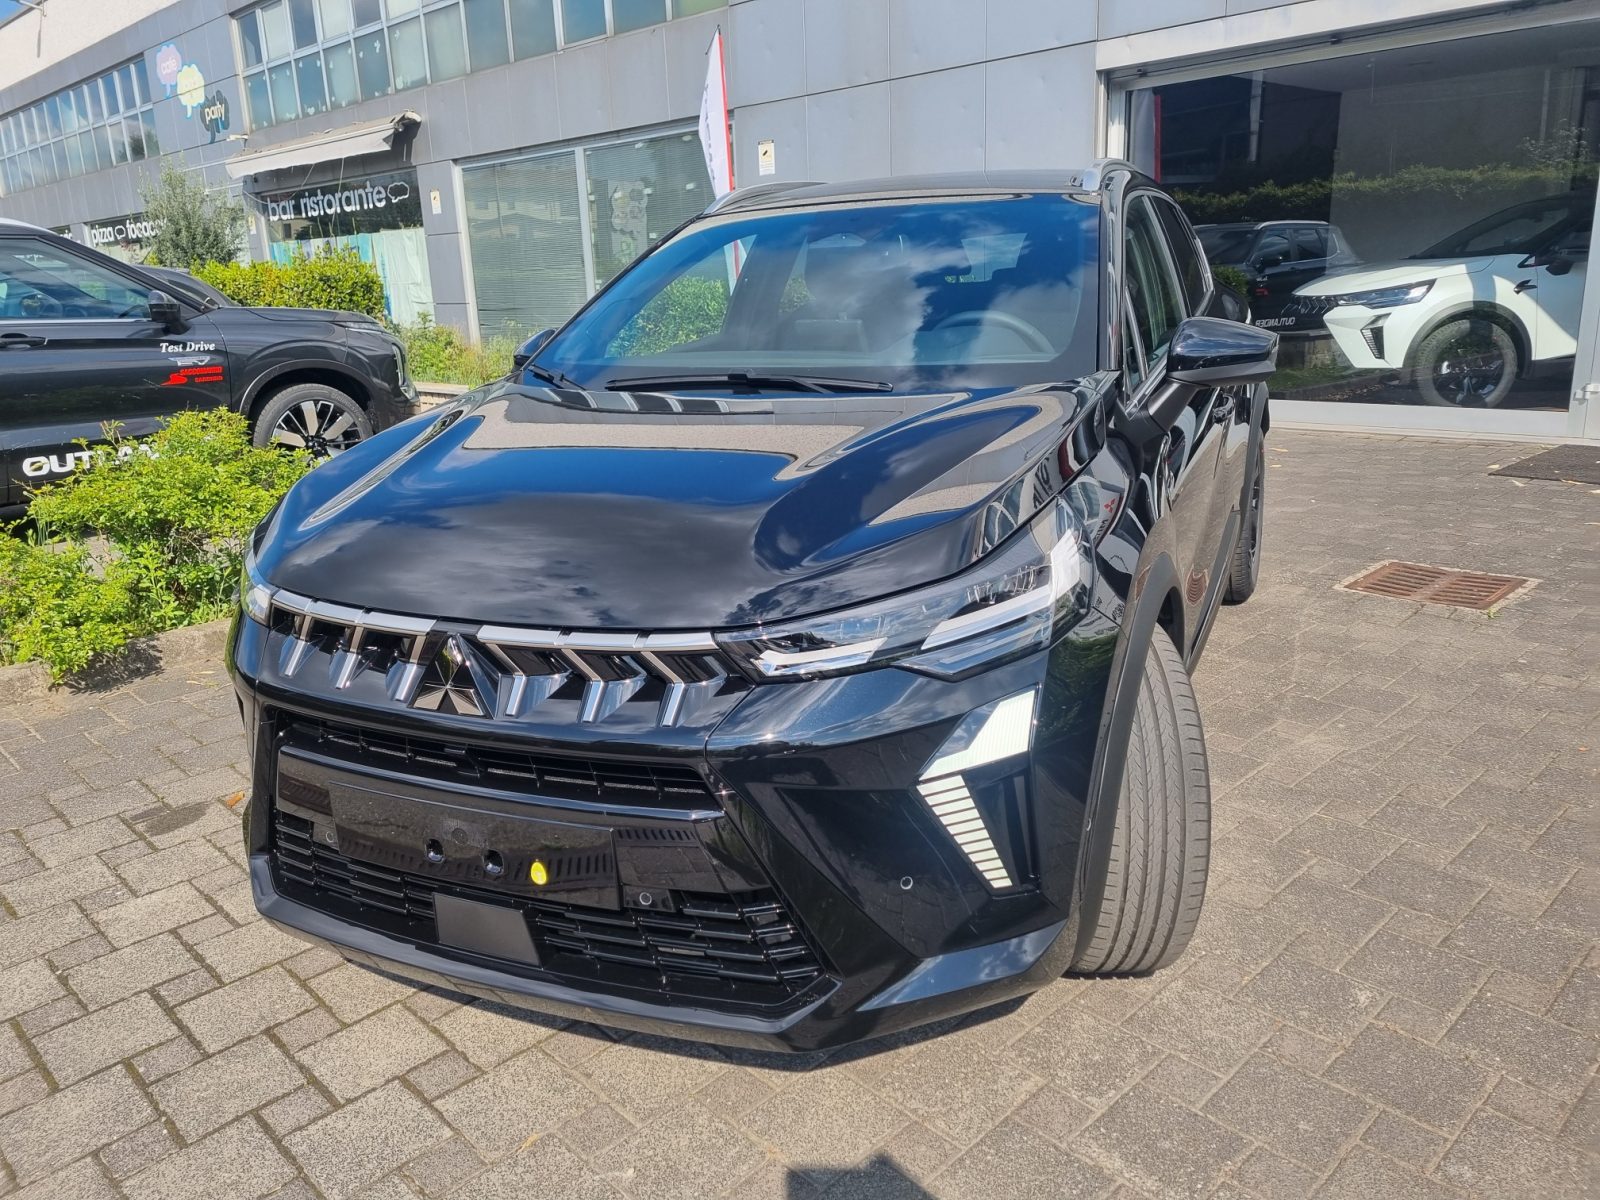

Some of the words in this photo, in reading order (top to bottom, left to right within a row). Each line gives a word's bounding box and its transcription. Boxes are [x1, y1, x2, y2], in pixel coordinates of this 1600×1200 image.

[204, 101, 225, 124] party
[267, 197, 296, 221] bar
[300, 180, 387, 218] ristorante
[91, 224, 115, 247] pizza
[160, 342, 184, 353] Test
[186, 341, 216, 352] Drive
